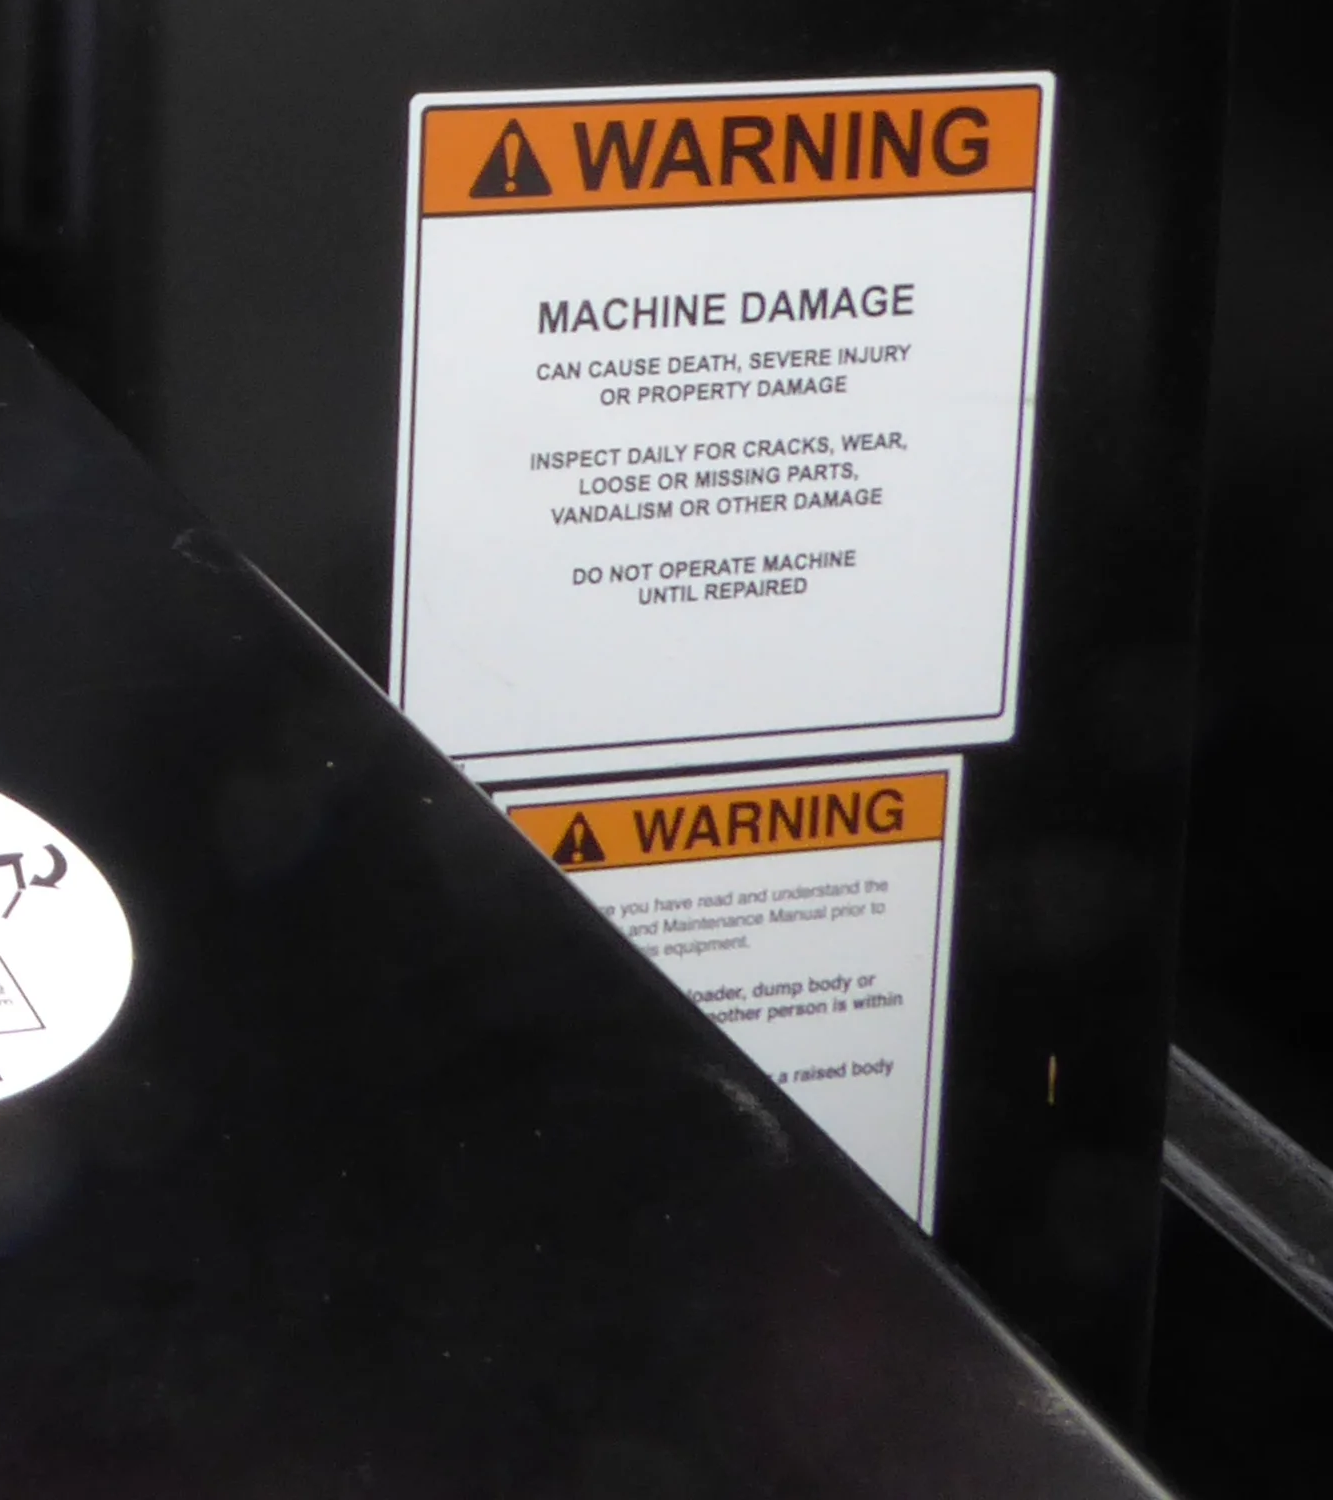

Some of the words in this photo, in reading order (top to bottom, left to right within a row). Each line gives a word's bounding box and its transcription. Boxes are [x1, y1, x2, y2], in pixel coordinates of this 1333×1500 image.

[573, 105, 990, 193] WARNING
[537, 293, 727, 335] MACHINE
[741, 283, 915, 324] DAMAGE
[536, 361, 581, 381] CAN
[588, 357, 661, 378] CAUSE
[668, 354, 742, 374] DEATH,
[749, 349, 831, 369] SEVERE
[838, 344, 912, 365] INJURY
[600, 388, 630, 406] OR
[637, 381, 751, 403] PROPERTY
[757, 376, 848, 397] DAMAGE
[530, 448, 621, 471] INSPECT
[627, 444, 688, 465] DAILY
[693, 442, 736, 461] FOR
[742, 436, 834, 458] CRACKS,
[841, 432, 907, 452] WEAR,
[579, 475, 651, 496] LOOSE
[658, 473, 688, 490] OR
[695, 467, 781, 488] MISSING
[787, 462, 859, 482] PARTS,
[552, 501, 674, 525] VANDALISM
[679, 499, 709, 517] OR
[716, 494, 788, 515] OTHER
[794, 488, 883, 510] DAMAGE
[572, 567, 602, 585] DO
[609, 563, 652, 583] NOT
[659, 556, 756, 580] OPERATE
[763, 550, 857, 572] MACHINE
[638, 584, 698, 605] UNTIL
[704, 577, 807, 600] REPAIRED
[633, 789, 905, 854] WARNING
[620, 902, 649, 918] you
[654, 898, 693, 912] have
[697, 892, 733, 907] read
[738, 889, 767, 905] and
[772, 881, 860, 901] understand
[864, 880, 888, 893] the
[629, 922, 658, 936] and
[663, 914, 763, 933] Maintenance
[769, 906, 827, 923] Manual
[831, 904, 866, 921] prior
[871, 902, 885, 915] to
[663, 936, 751, 958] equipment.
[752, 982, 803, 997] dump
[808, 974, 852, 993] body
[857, 974, 876, 988] or
[767, 1001, 827, 1022] person
[832, 998, 847, 1012] is
[853, 992, 903, 1010] within
[778, 1071, 788, 1084] a
[794, 1062, 847, 1083] raised
[852, 1058, 894, 1077] body
